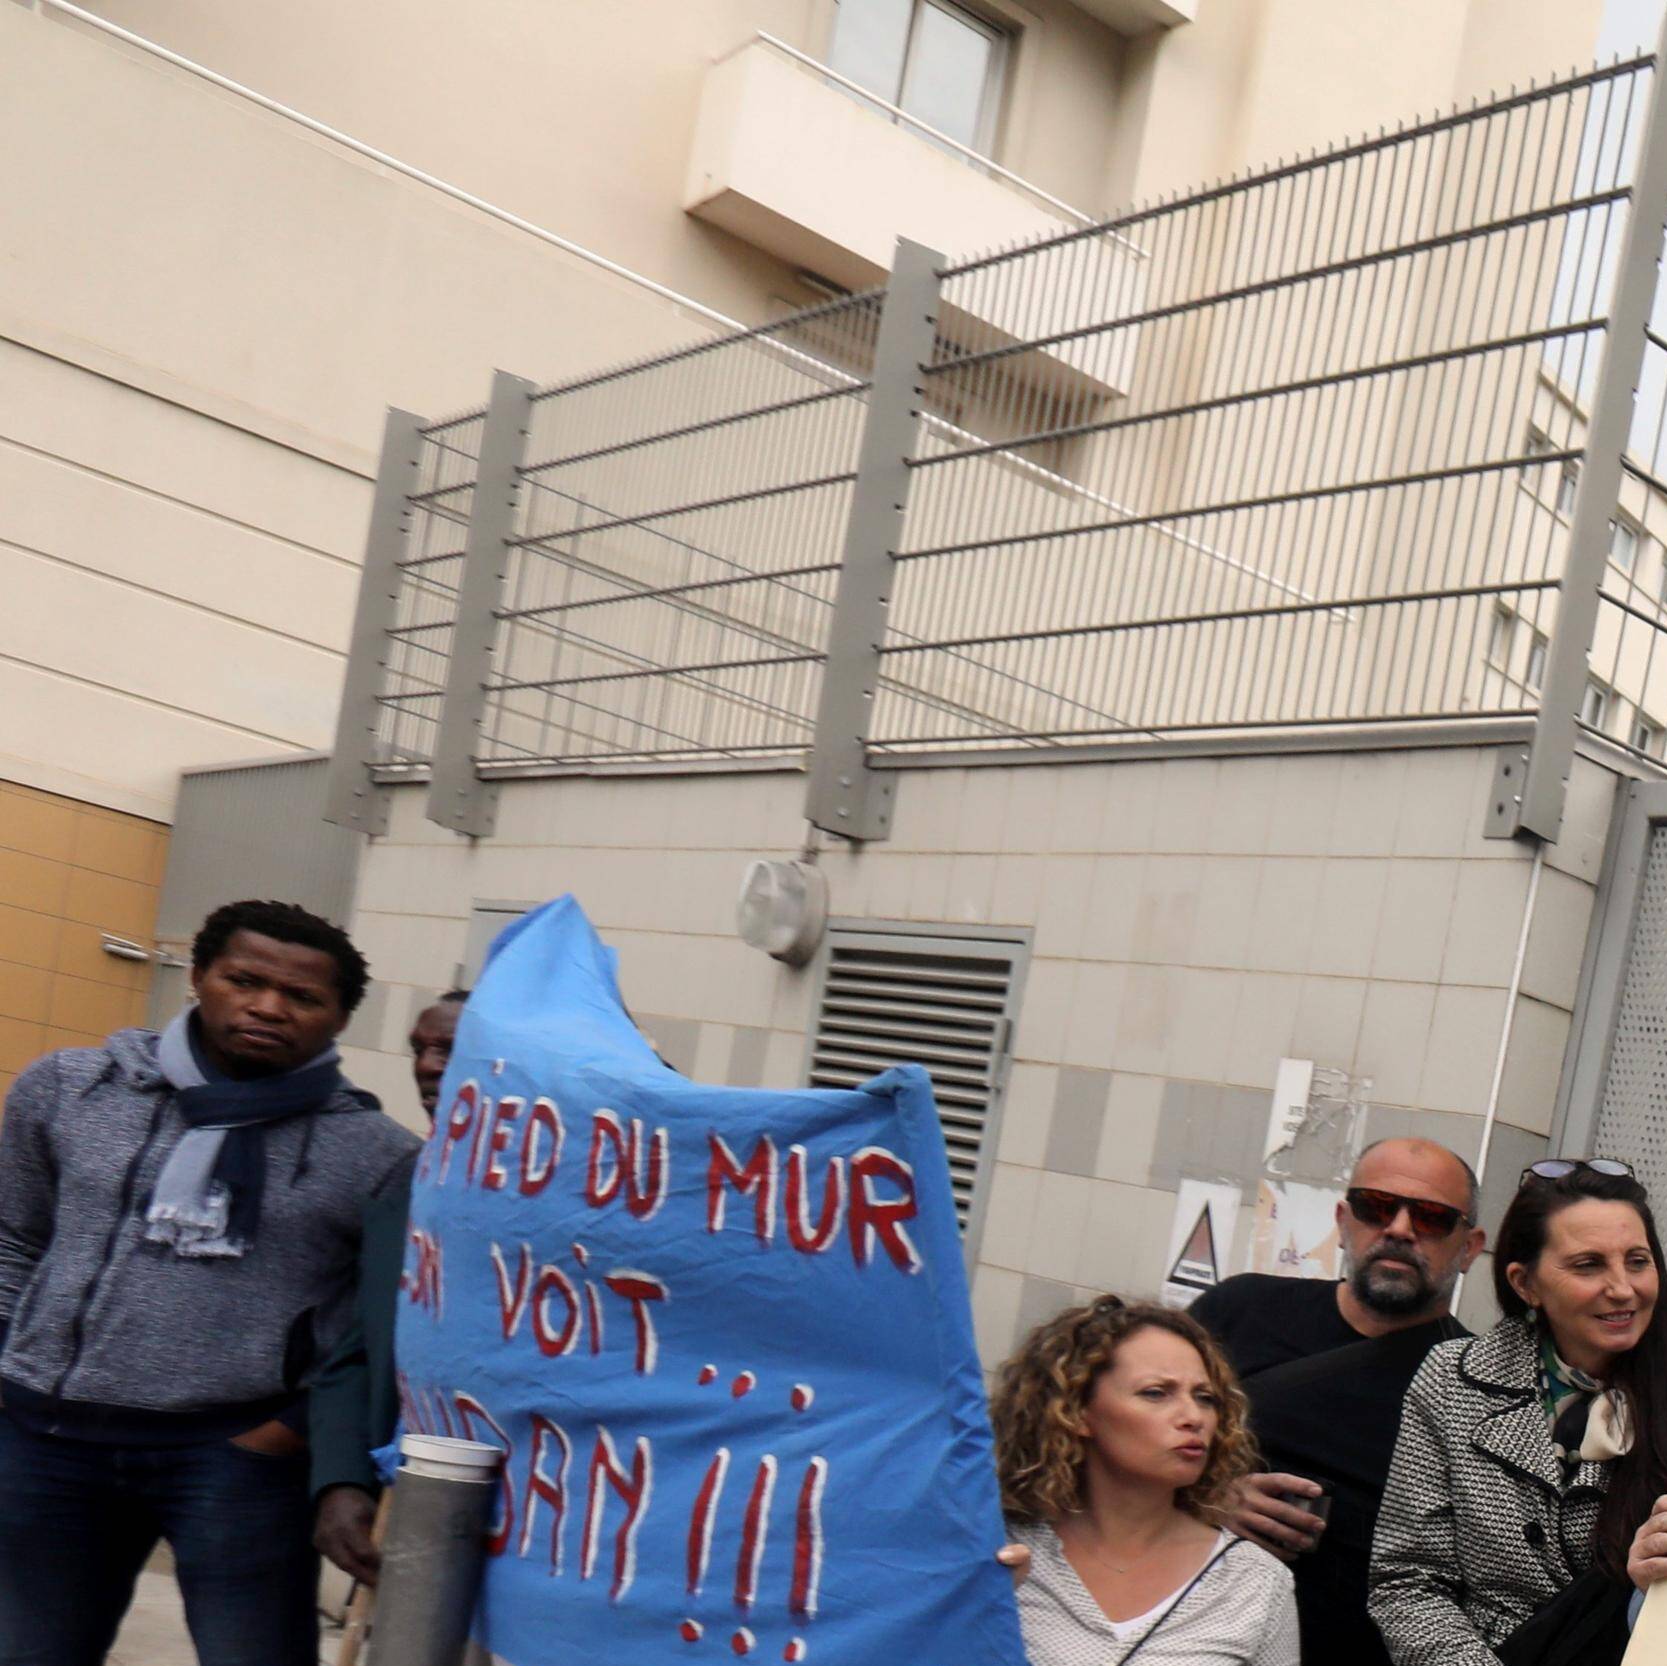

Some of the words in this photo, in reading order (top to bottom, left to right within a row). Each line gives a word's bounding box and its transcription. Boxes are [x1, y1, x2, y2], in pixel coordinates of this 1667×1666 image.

[585, 1109, 669, 1221] DU
[706, 1128, 923, 1275] MUR
[679, 1447, 829, 1663] !!!
